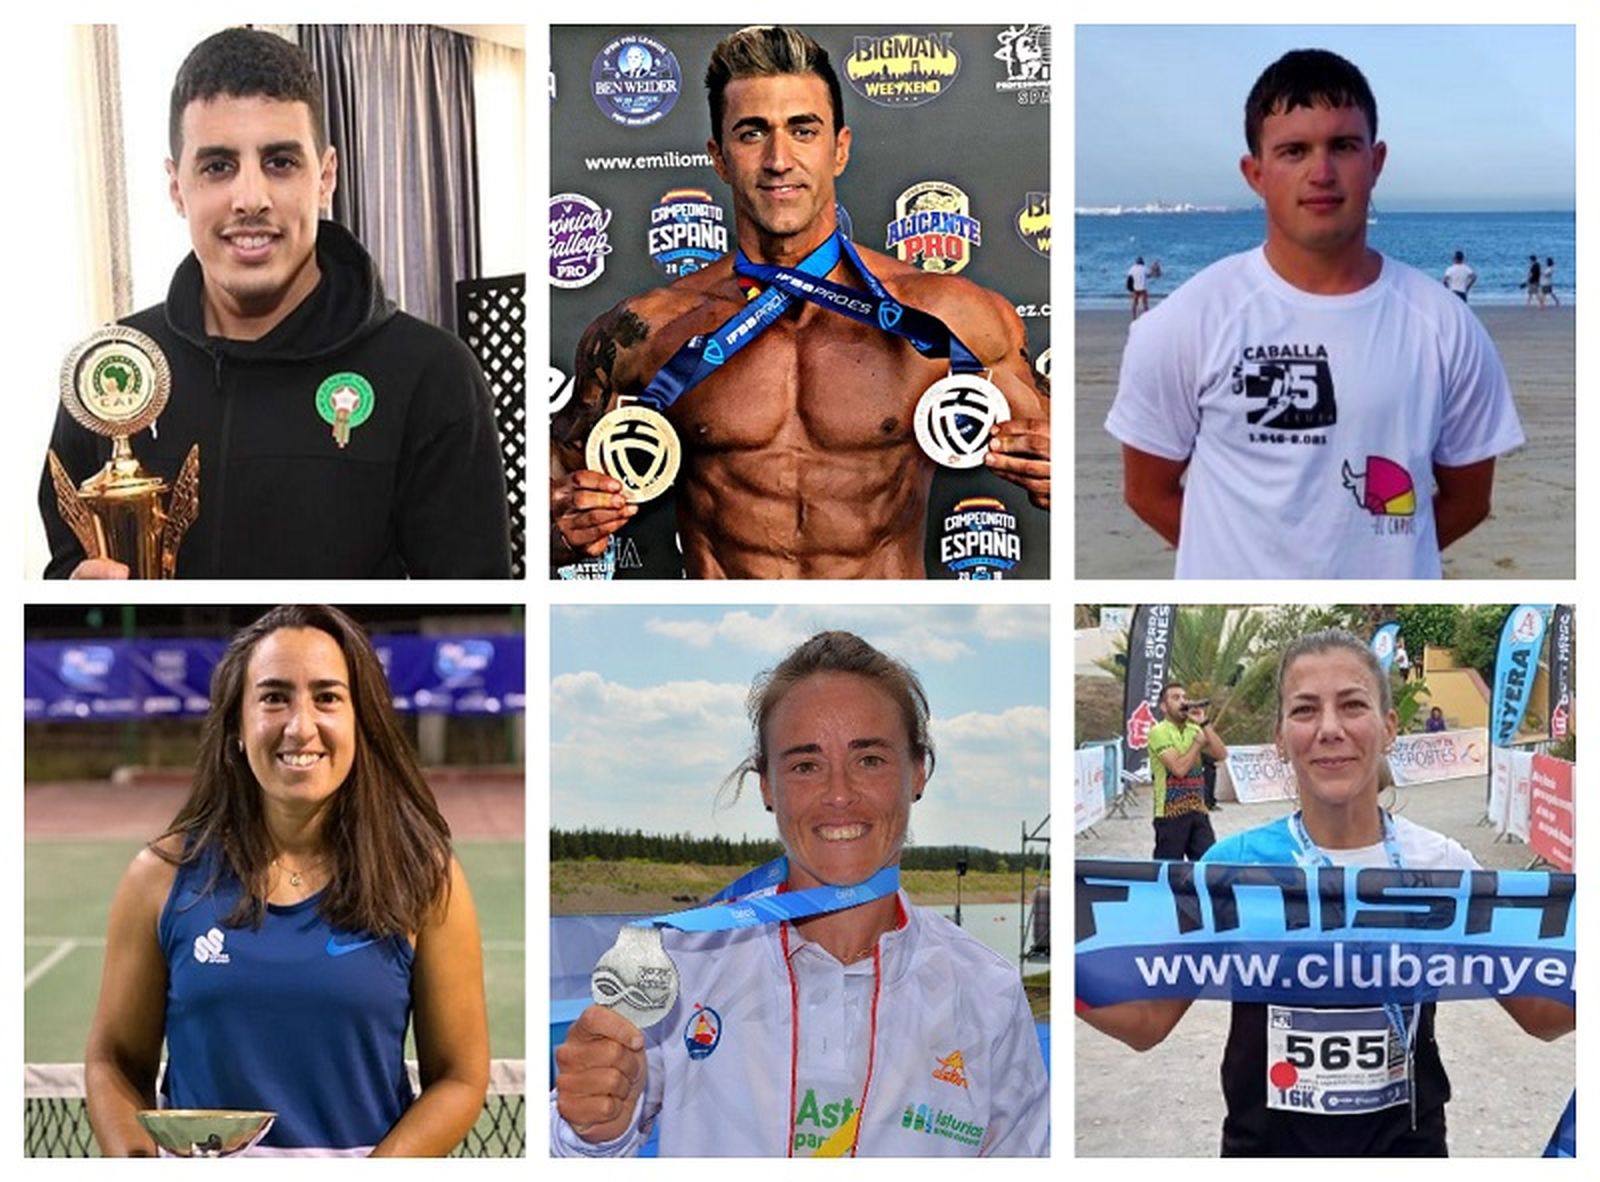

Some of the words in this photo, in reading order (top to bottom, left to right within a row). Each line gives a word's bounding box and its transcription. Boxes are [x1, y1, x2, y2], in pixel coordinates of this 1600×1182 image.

[854, 32, 952, 62] BIGMAN
[595, 81, 622, 95] BEN
[624, 79, 677, 93] WEIDER
[651, 203, 723, 223] CAMPEONATO
[649, 219, 728, 255] ESPAÑA
[887, 211, 981, 248] ALICANTE
[904, 234, 963, 262] PRO
[557, 265, 587, 277] PRO
[1243, 344, 1328, 360] CABALLA
[944, 511, 1016, 532] CAMPEONATO
[941, 527, 1020, 563] ESPAÑA
[1075, 860, 1576, 941] FINISH
[1286, 1034, 1385, 1071] 565
[1278, 1087, 1315, 1109] 16K
